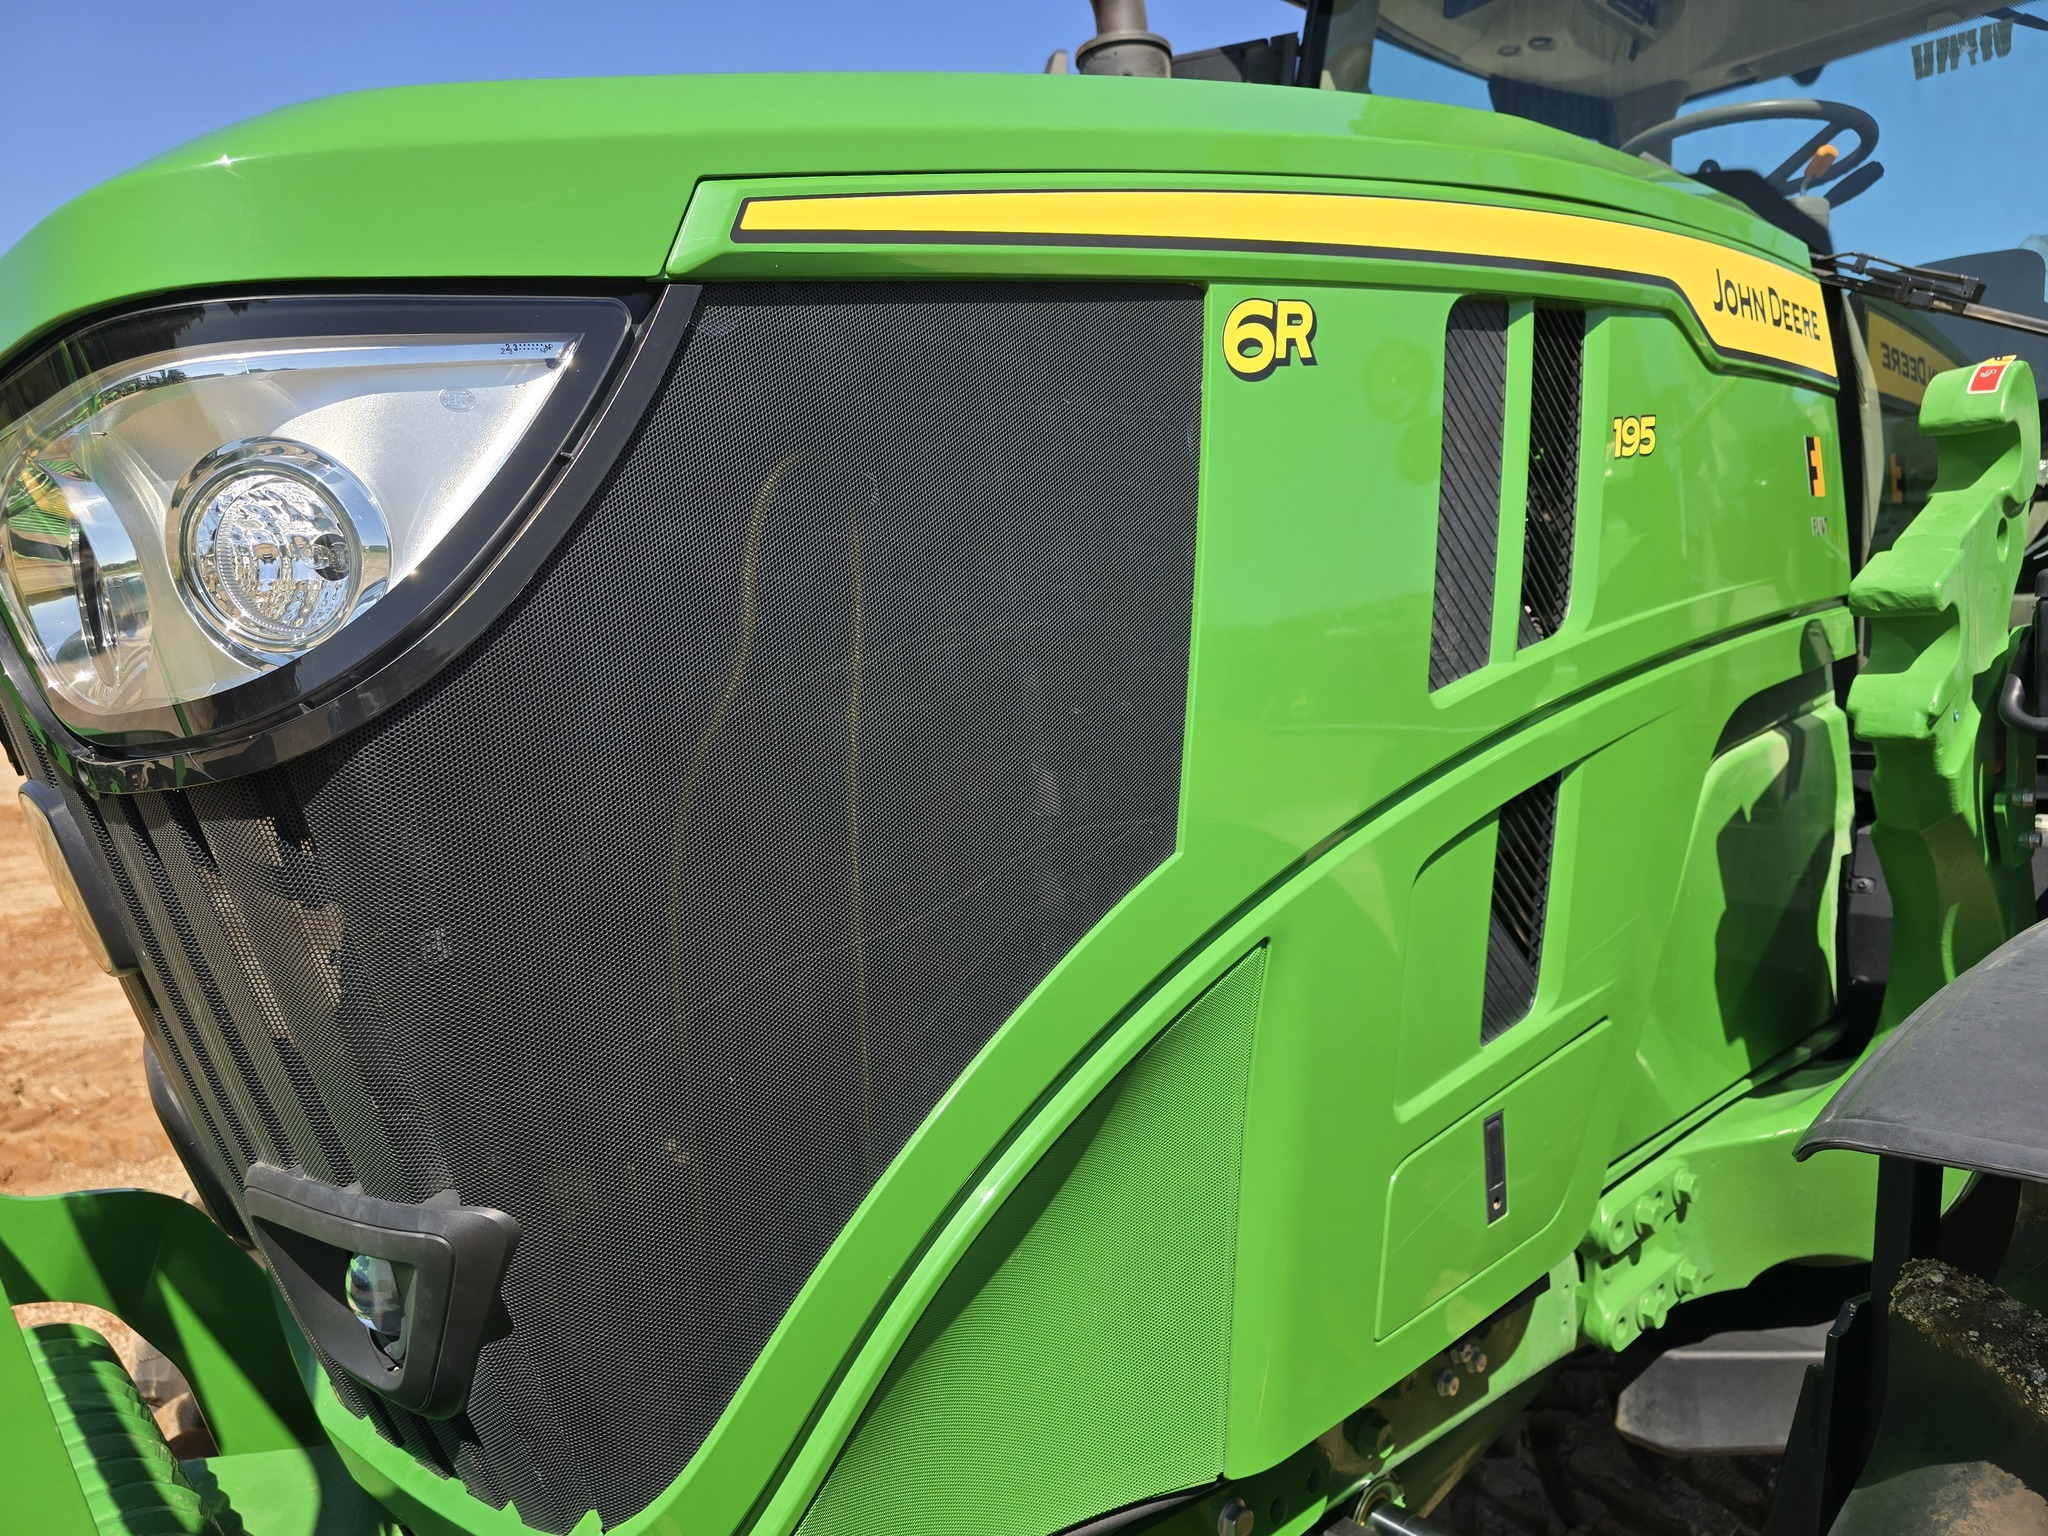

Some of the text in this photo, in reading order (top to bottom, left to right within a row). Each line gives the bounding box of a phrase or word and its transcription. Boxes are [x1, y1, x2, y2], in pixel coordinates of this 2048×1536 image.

[1223, 298, 1318, 382] 6R
[1713, 268, 1821, 341] JOHN DEERE
[1613, 414, 1656, 459] 195
